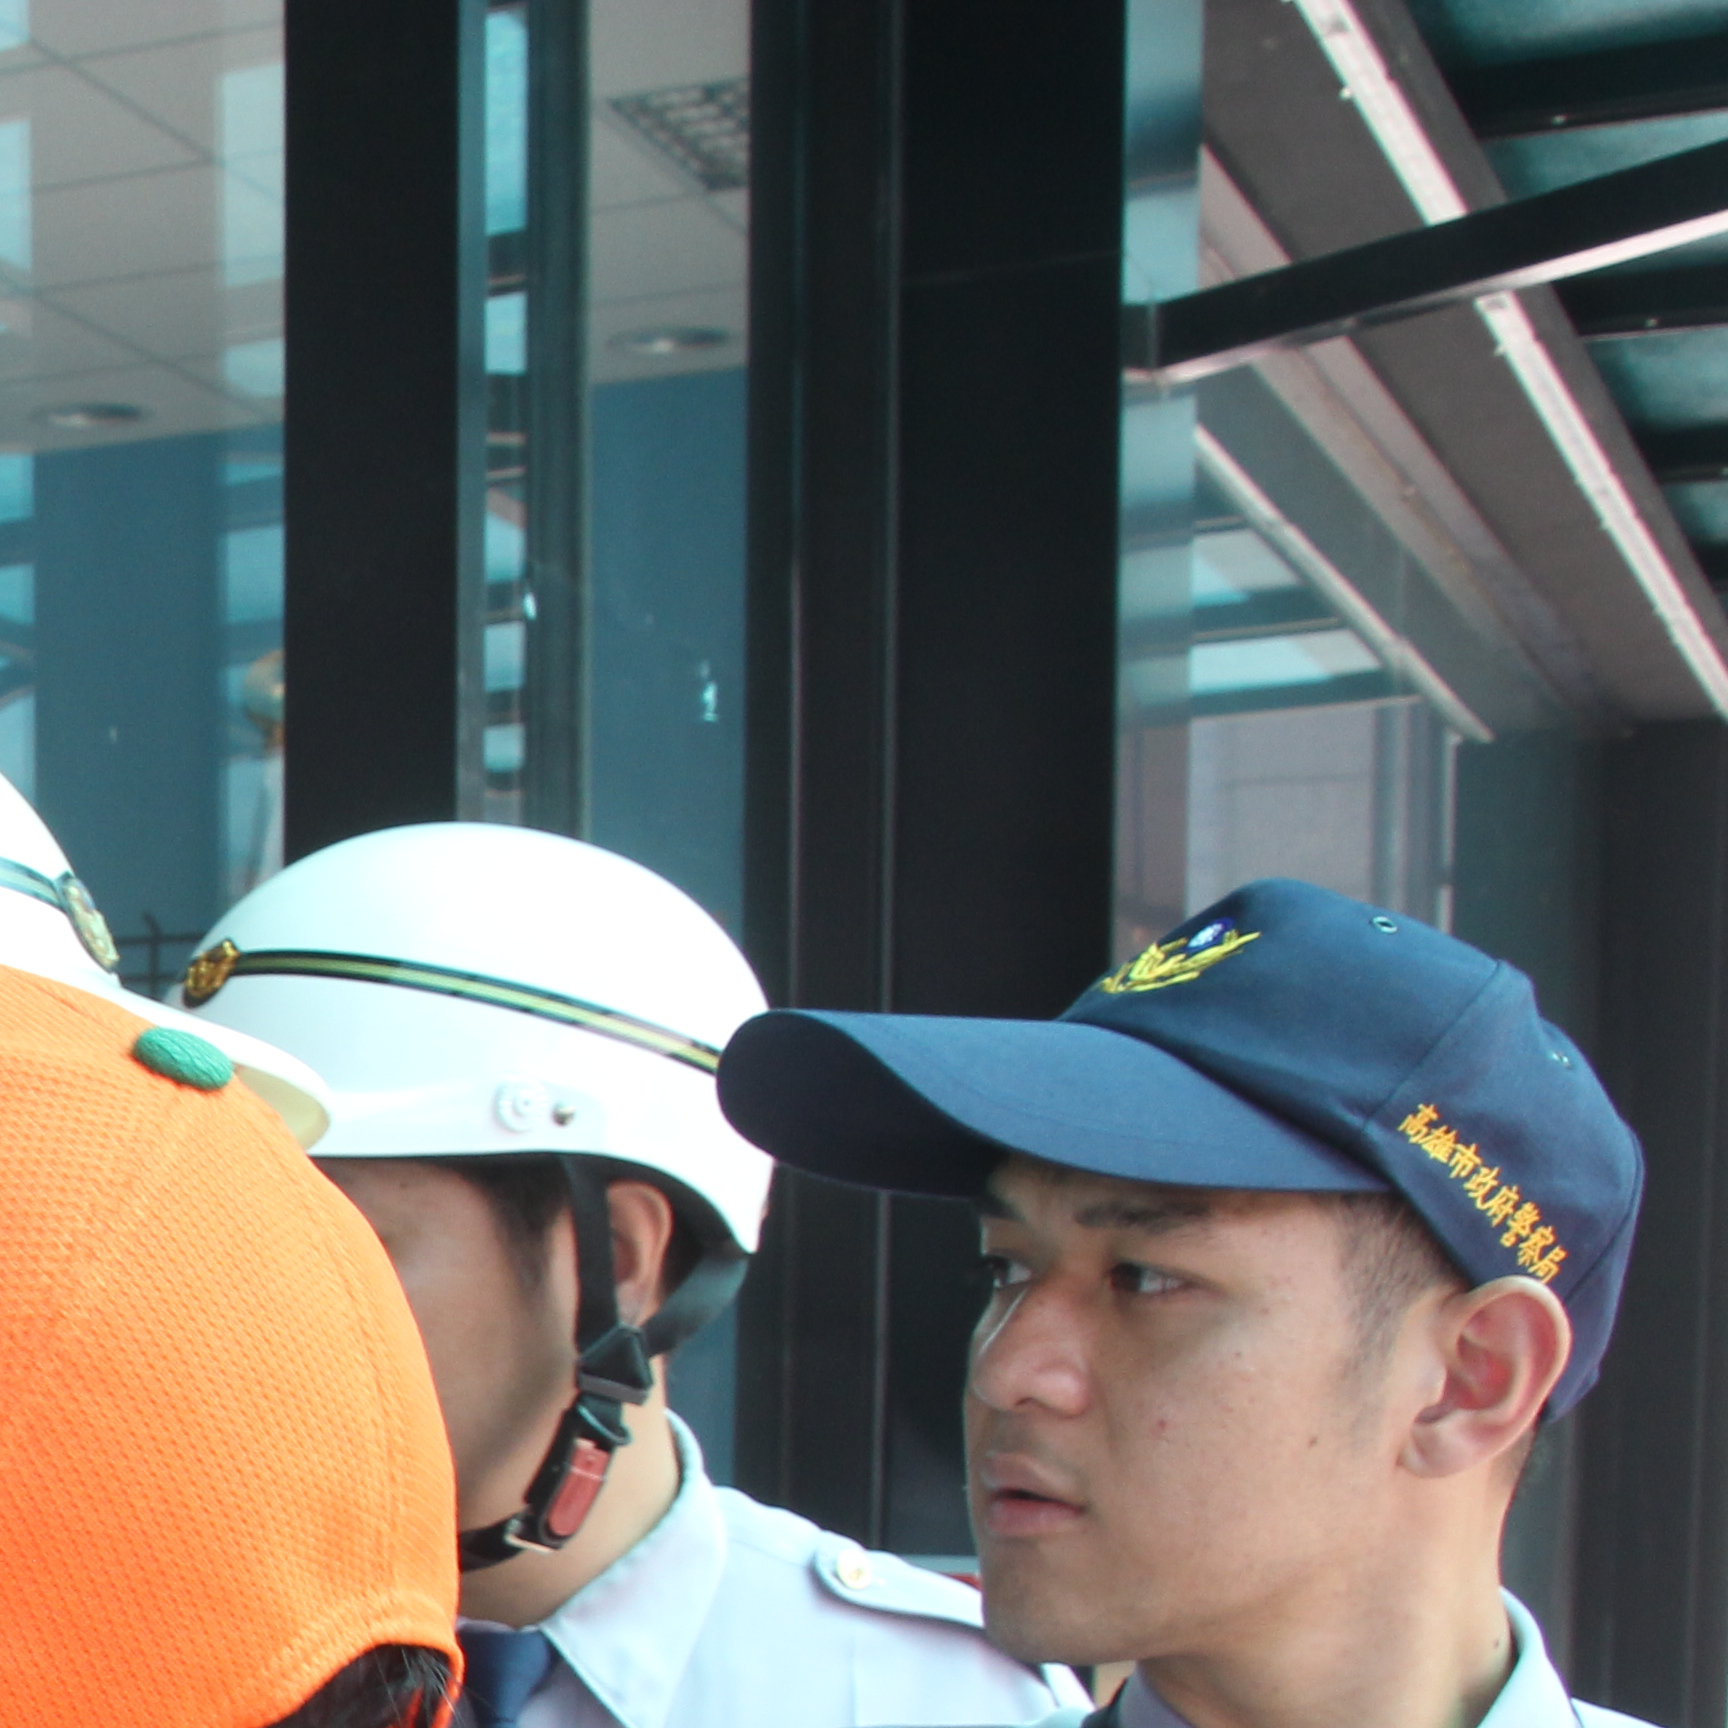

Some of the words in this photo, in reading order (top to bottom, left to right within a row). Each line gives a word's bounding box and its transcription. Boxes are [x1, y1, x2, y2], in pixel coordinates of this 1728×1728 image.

[1398, 1103, 1569, 1284] 高雄市政府警察局
